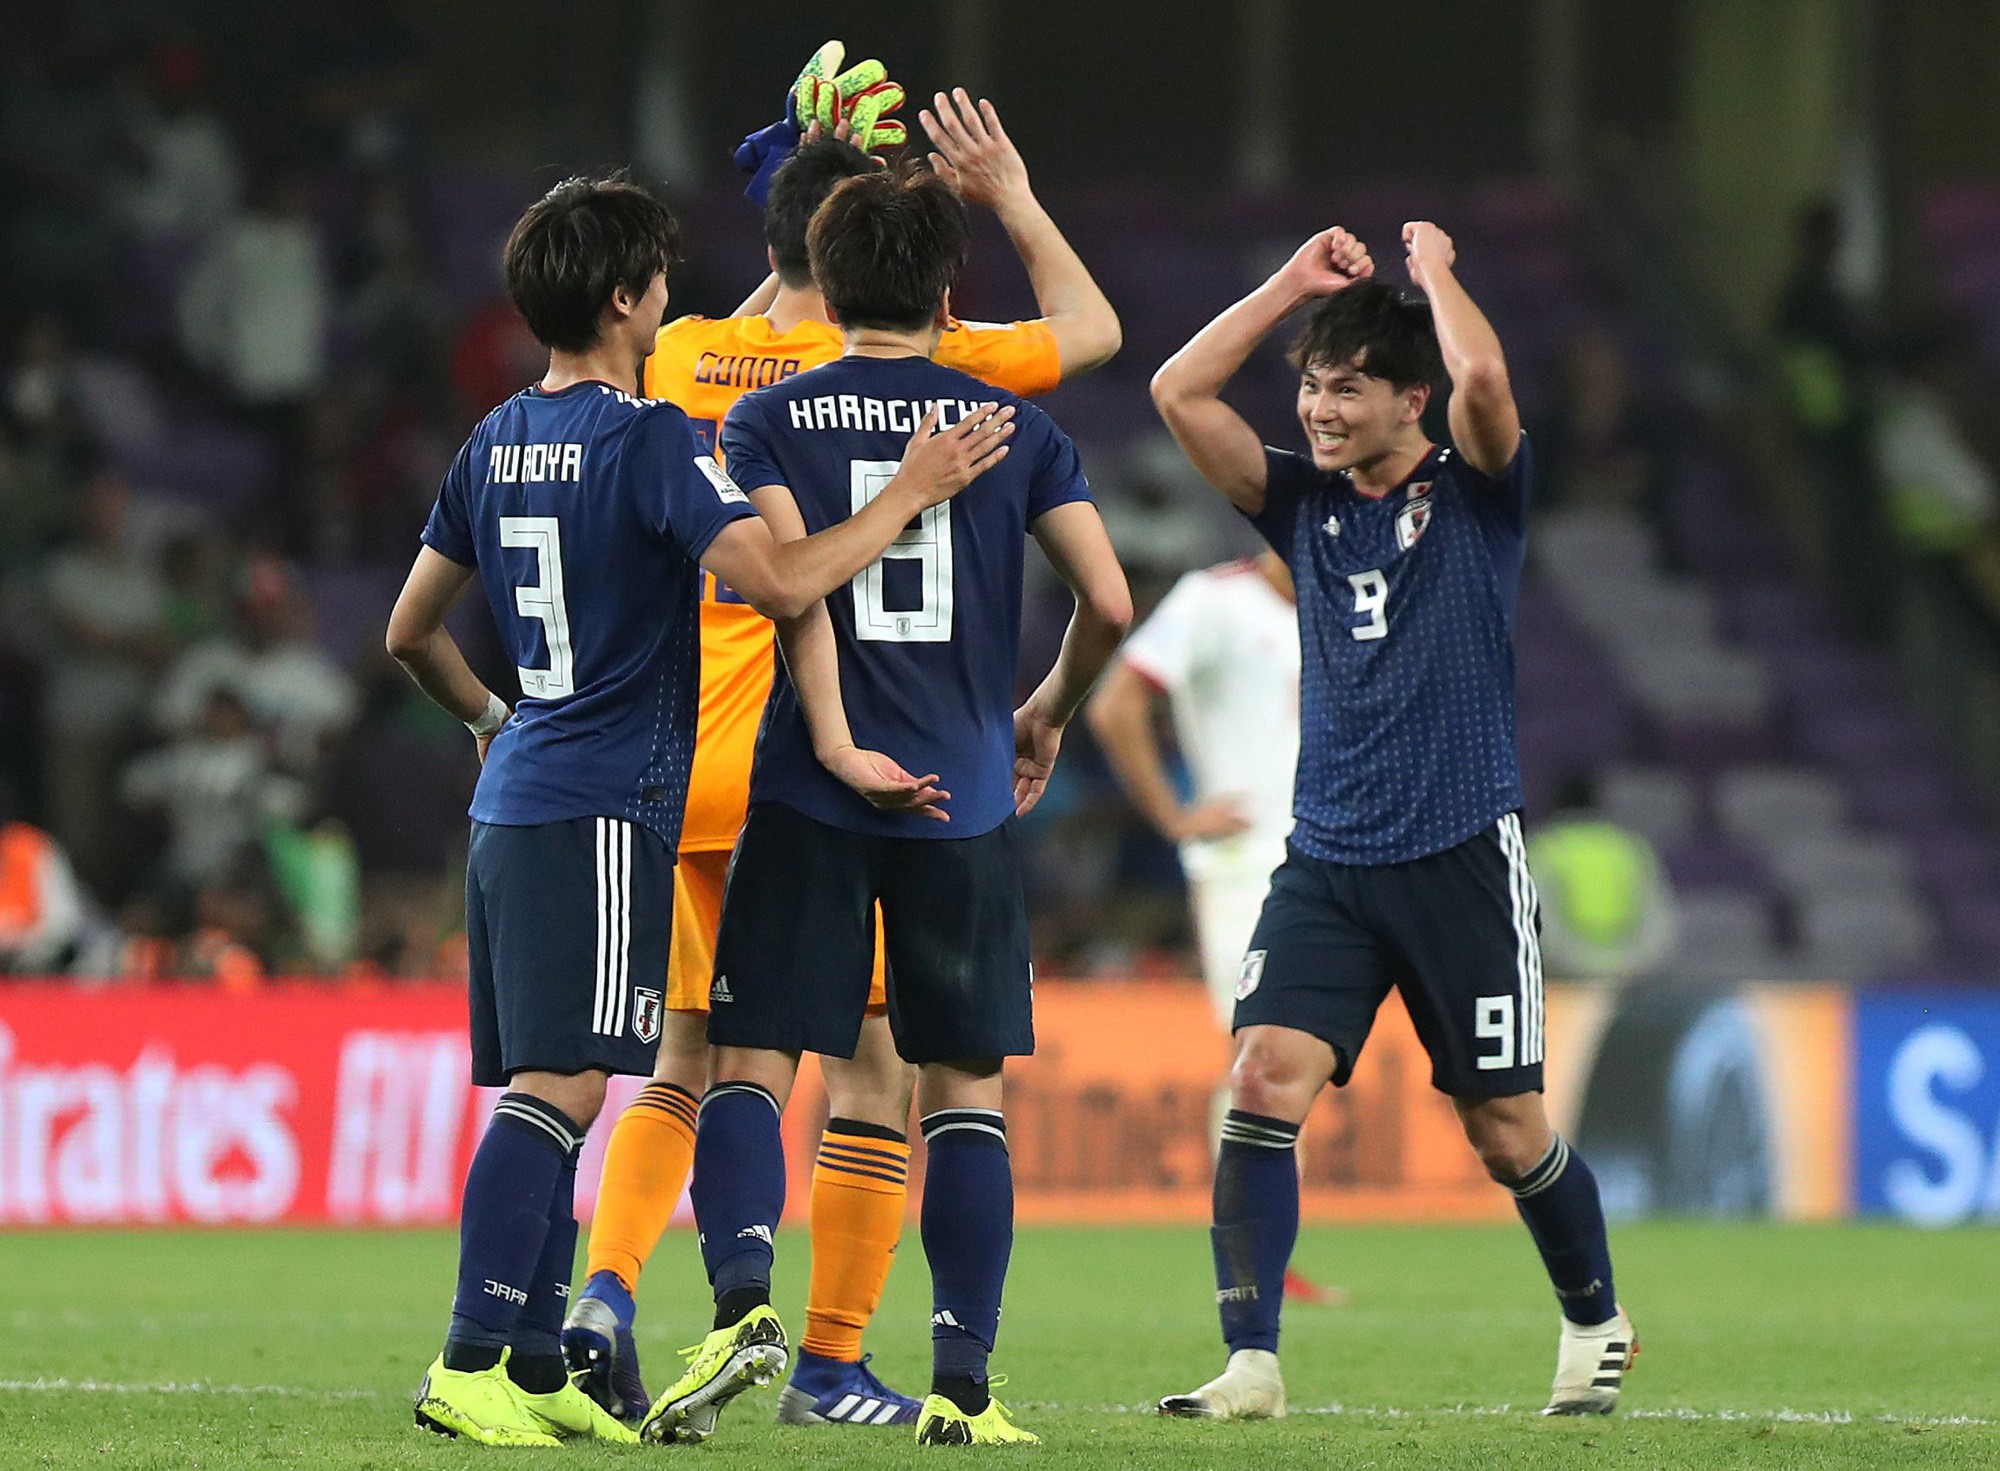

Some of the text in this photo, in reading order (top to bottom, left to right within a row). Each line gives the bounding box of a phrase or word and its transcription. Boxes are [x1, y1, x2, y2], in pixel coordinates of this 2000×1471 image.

[499, 517, 574, 700] 3
[851, 459, 953, 642] 8
[1347, 568, 1389, 641] 9
[1475, 994, 1515, 1070] 9
